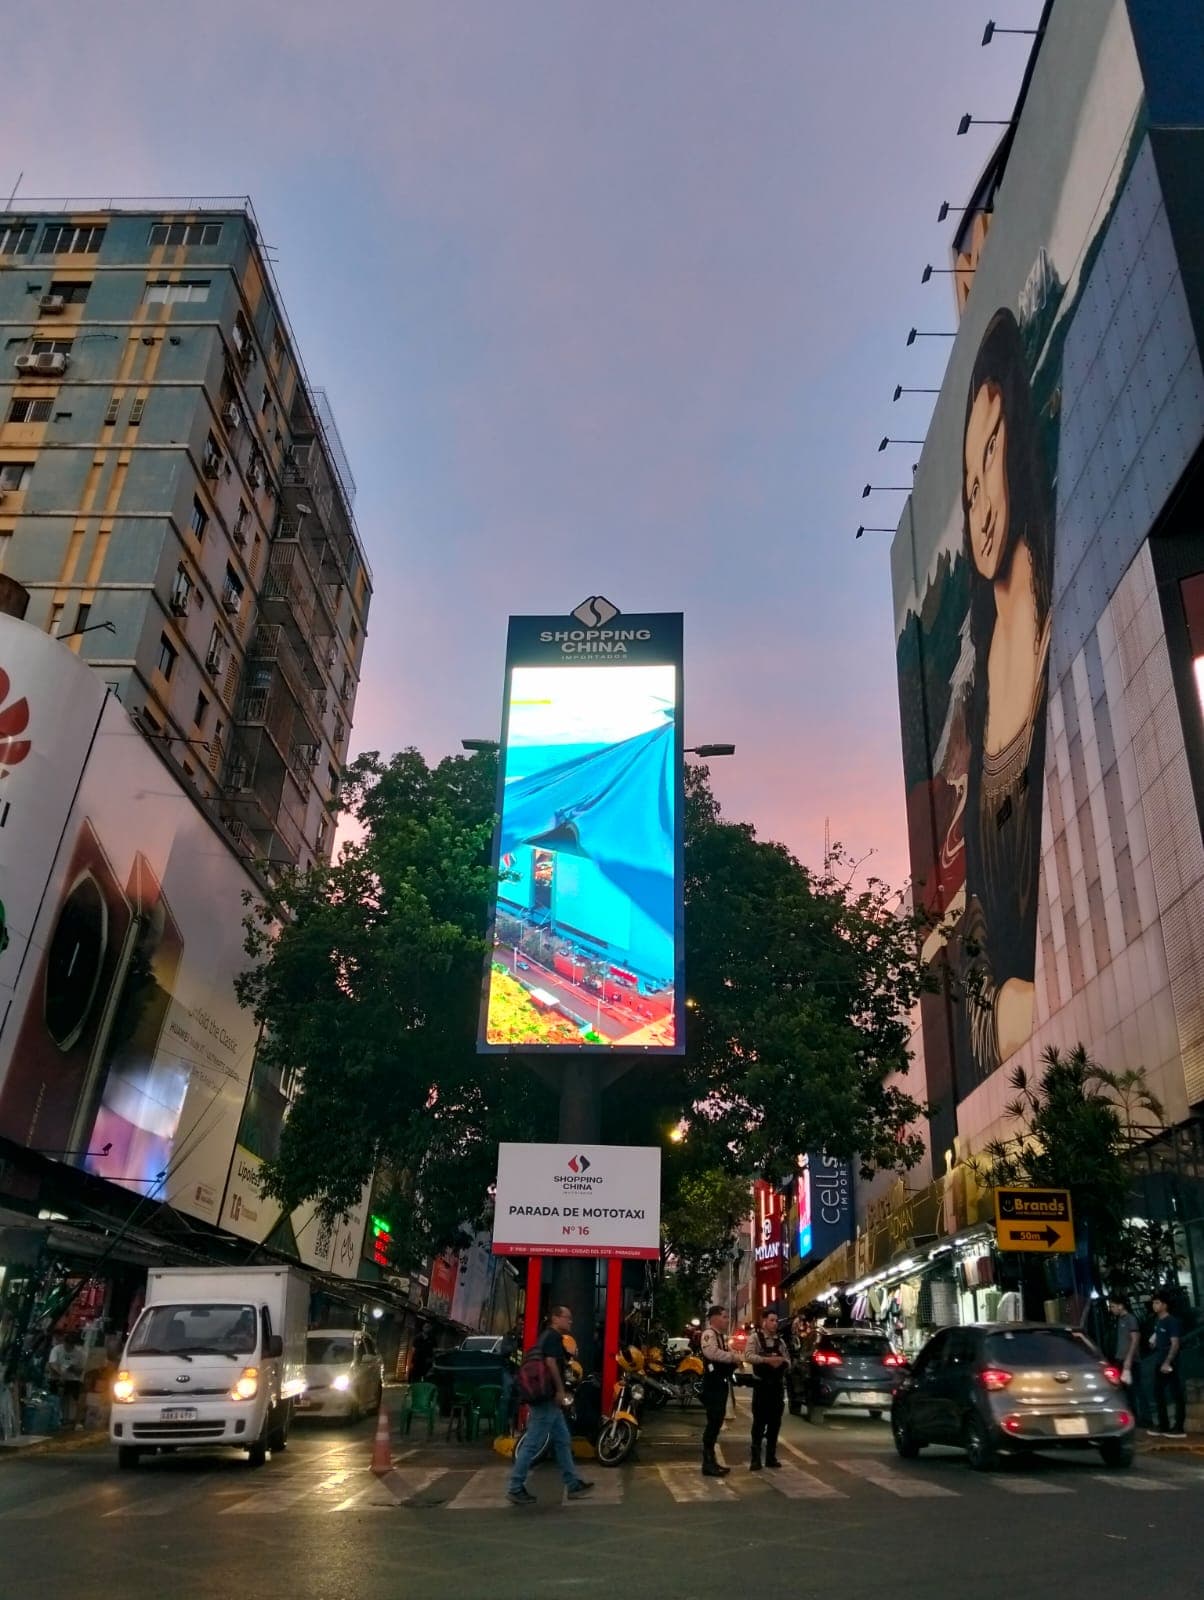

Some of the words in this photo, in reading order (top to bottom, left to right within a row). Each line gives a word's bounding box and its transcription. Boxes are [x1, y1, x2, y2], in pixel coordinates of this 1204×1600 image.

[540, 630, 651, 642] SHOPPING
[561, 642, 627, 653] CHINA
[553, 1175, 604, 1184] SHOPPING
[815, 1146, 841, 1224] cells
[562, 1183, 592, 1191] CHINA
[839, 1160, 849, 1211] IMPORT
[1014, 1198, 1065, 1212] Brands
[509, 1206, 559, 1217] PARADA
[563, 1207, 579, 1217] DE
[583, 1208, 645, 1219] MOTOTAXI
[579, 1226, 590, 1236] 16
[1020, 1231, 1040, 1240] 50m
